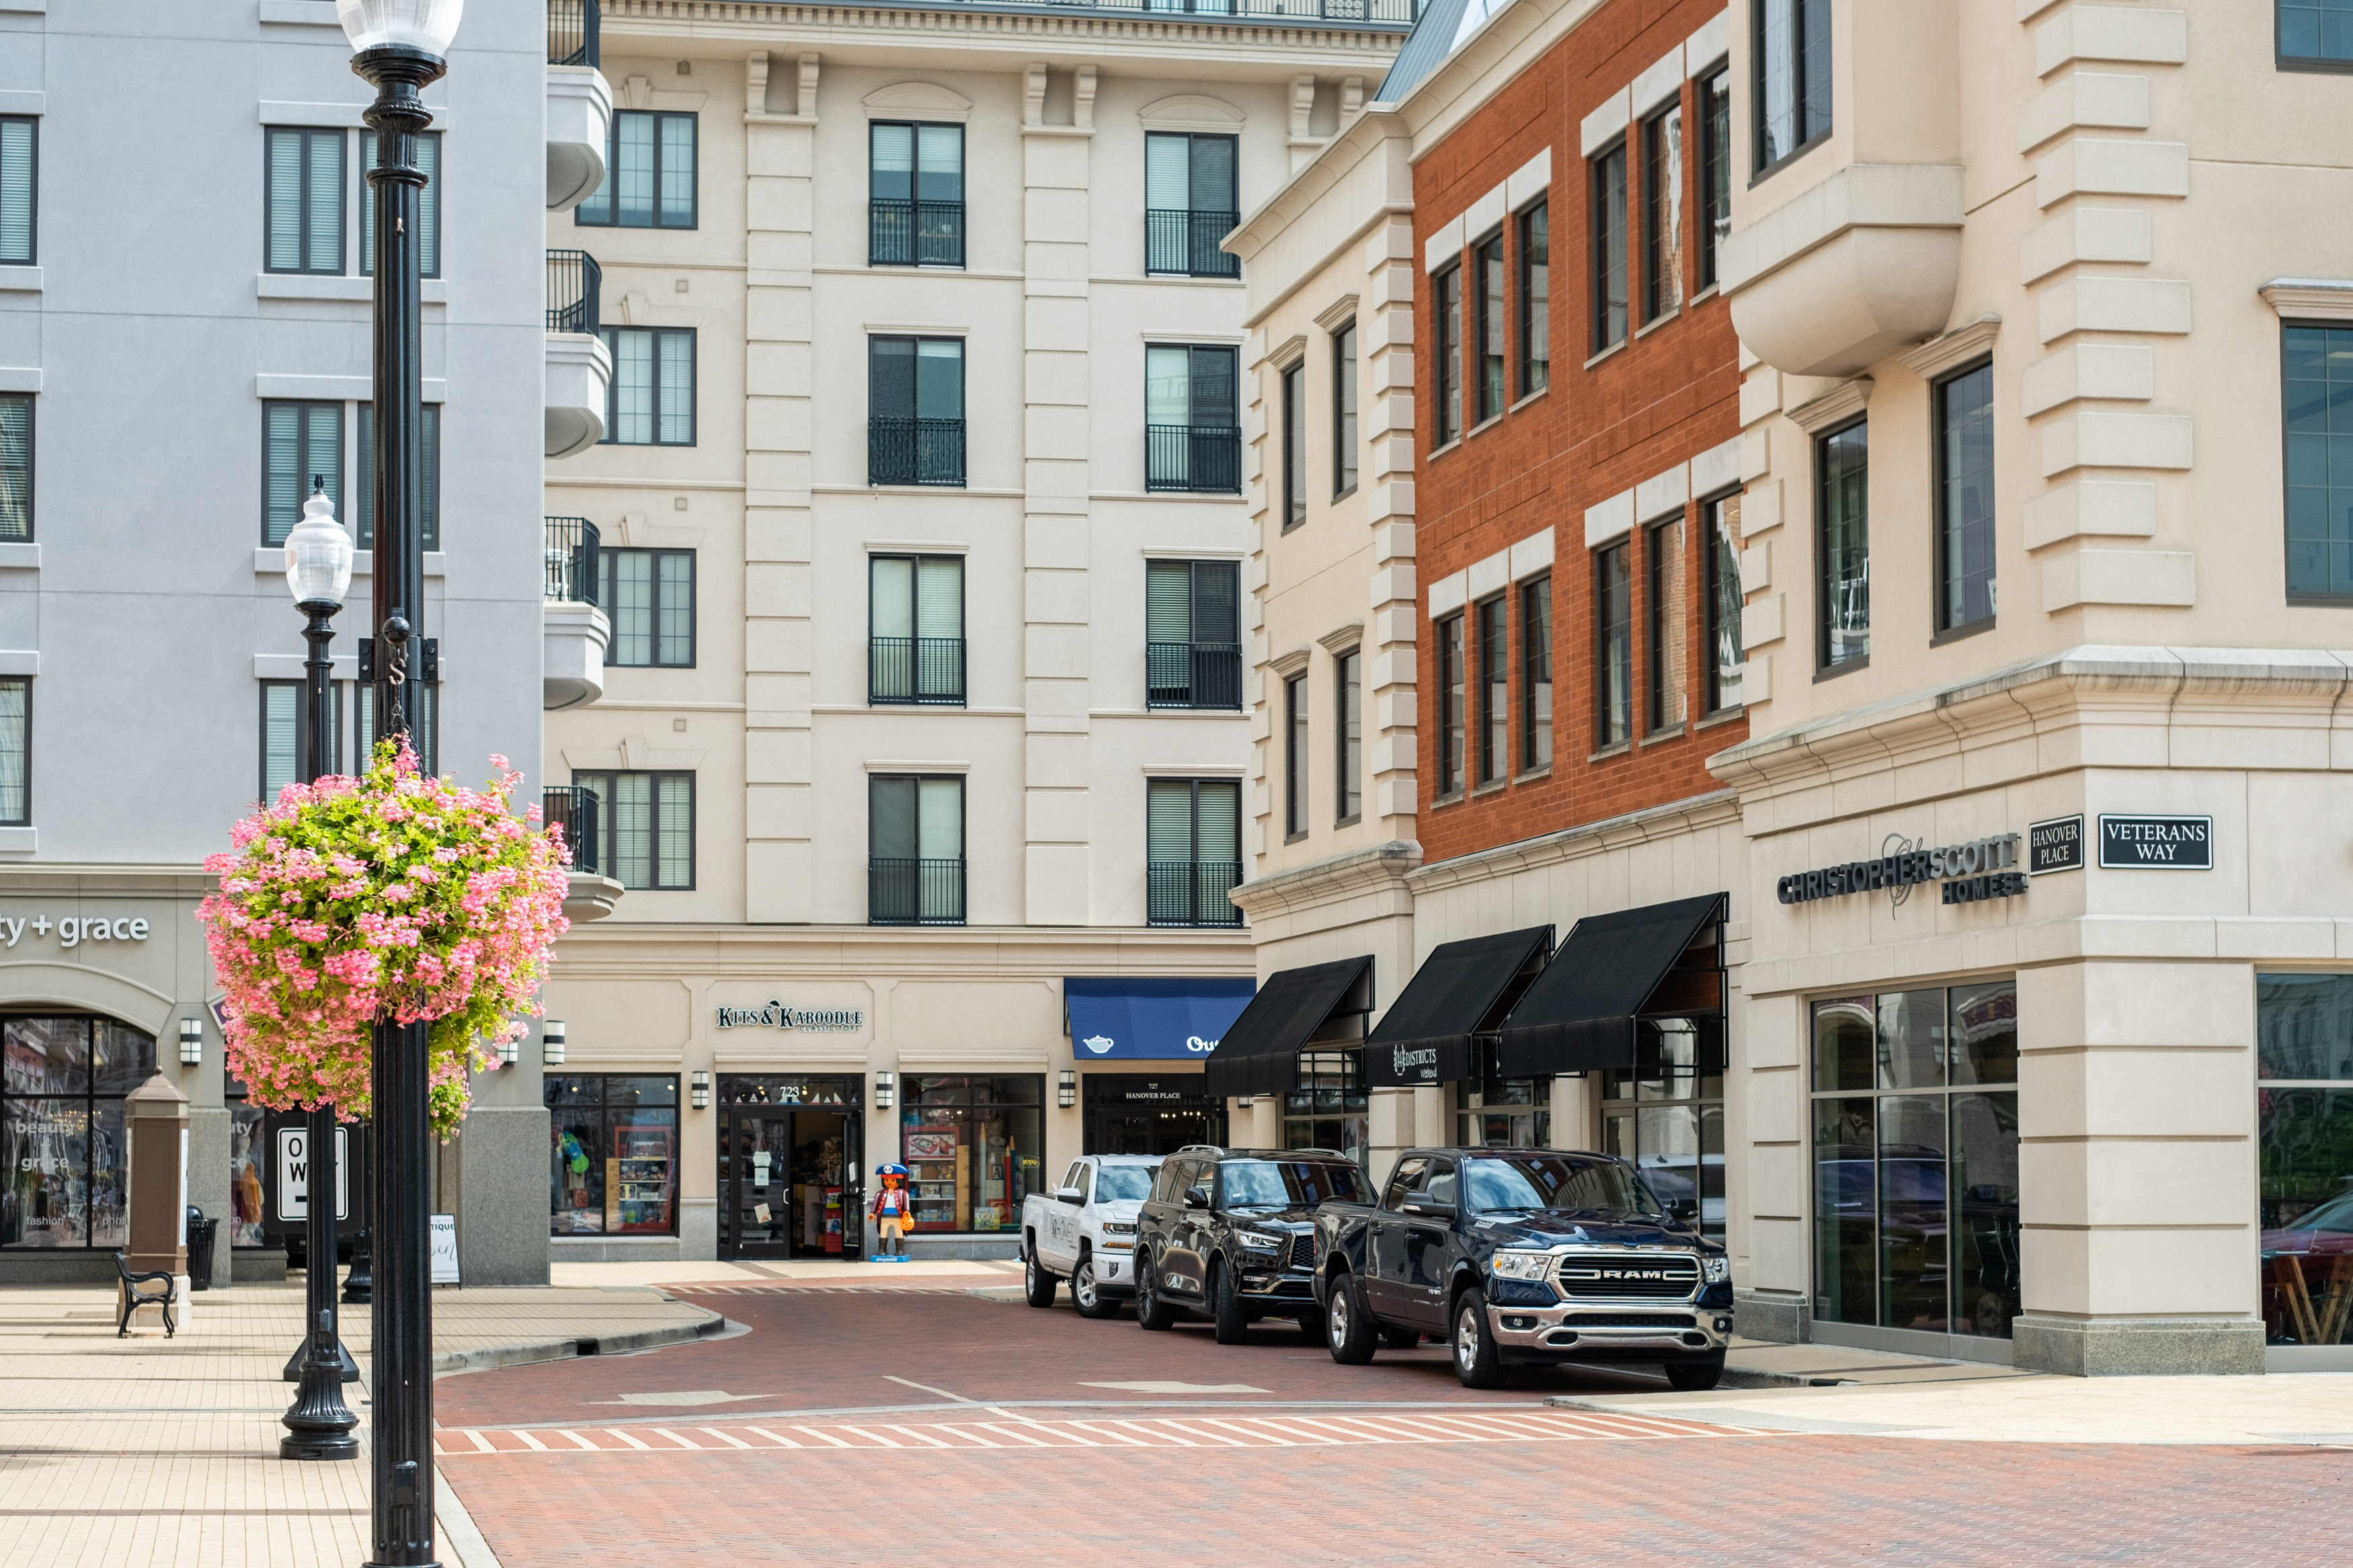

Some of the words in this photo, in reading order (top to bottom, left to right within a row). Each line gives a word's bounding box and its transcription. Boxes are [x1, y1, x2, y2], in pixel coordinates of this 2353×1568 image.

[2033, 824, 2078, 848] HANOVER
[2107, 823, 2205, 841] VETERANS
[2041, 845, 2069, 864] PLACE
[2135, 843, 2177, 860] WAY
[1942, 872, 2022, 905] HOMES
[58, 916, 149, 948] grace
[760, 1008, 774, 1025] &
[779, 1007, 863, 1028] KABOODLE
[1405, 1048, 1437, 1066] DISTRICTS
[780, 1086, 800, 1097] 723
[15, 1120, 76, 1137] beauty
[26, 1216, 64, 1225] fashion
[1603, 1270, 1661, 1279] RAM
